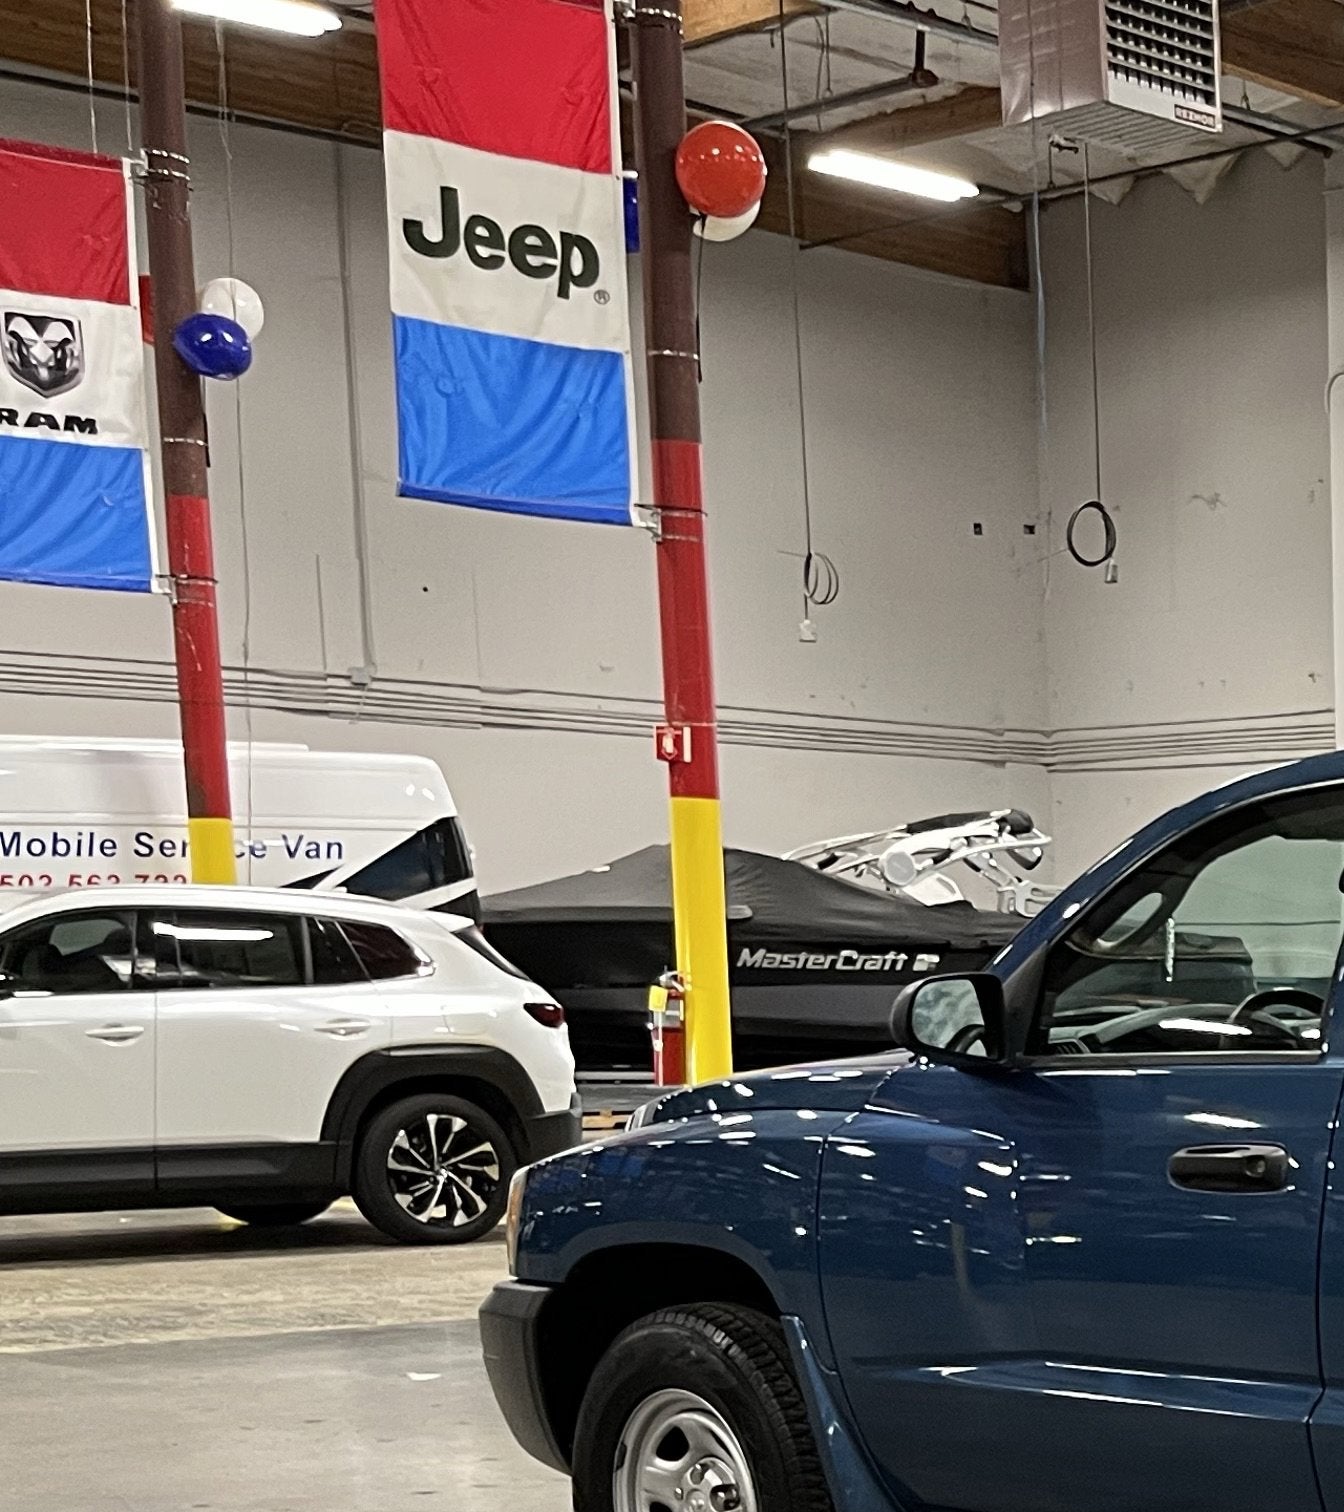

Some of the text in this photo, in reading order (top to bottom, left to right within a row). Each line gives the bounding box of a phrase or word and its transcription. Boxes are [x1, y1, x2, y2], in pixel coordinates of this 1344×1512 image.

[403, 186, 600, 300] Jeep
[0, 408, 98, 435] RAM
[0, 832, 343, 859] Mobile Serce Van
[736, 948, 908, 971] MasterCraft
